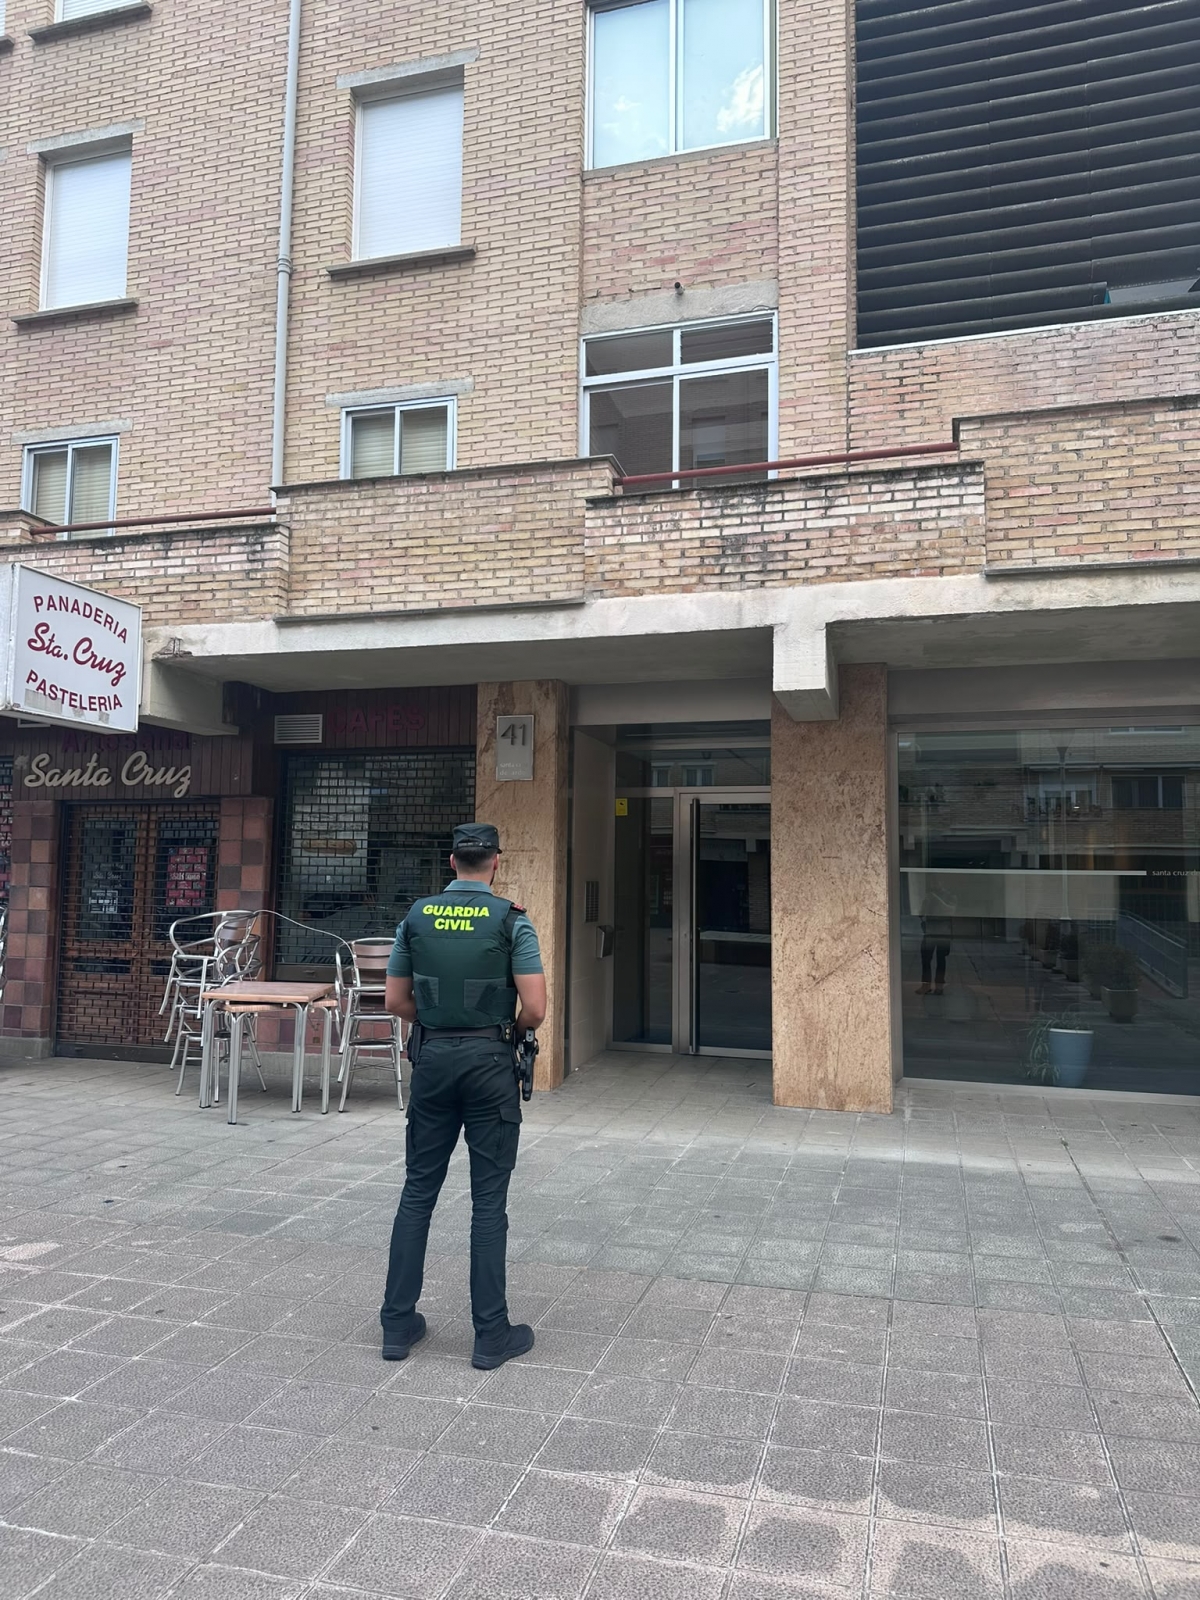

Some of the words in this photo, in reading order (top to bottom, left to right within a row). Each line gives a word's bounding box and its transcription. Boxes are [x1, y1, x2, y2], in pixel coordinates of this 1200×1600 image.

[34, 595, 128, 643] PANADERIA
[27, 622, 69, 661] Sta.
[73, 637, 127, 687] Cruz
[26, 669, 123, 712] PASTELERIA
[500, 723, 527, 746] 41
[24, 753, 112, 788] Santa
[121, 751, 192, 798] Cruz
[422, 904, 490, 918] GUARDIA
[434, 918, 475, 931] CIVIL
